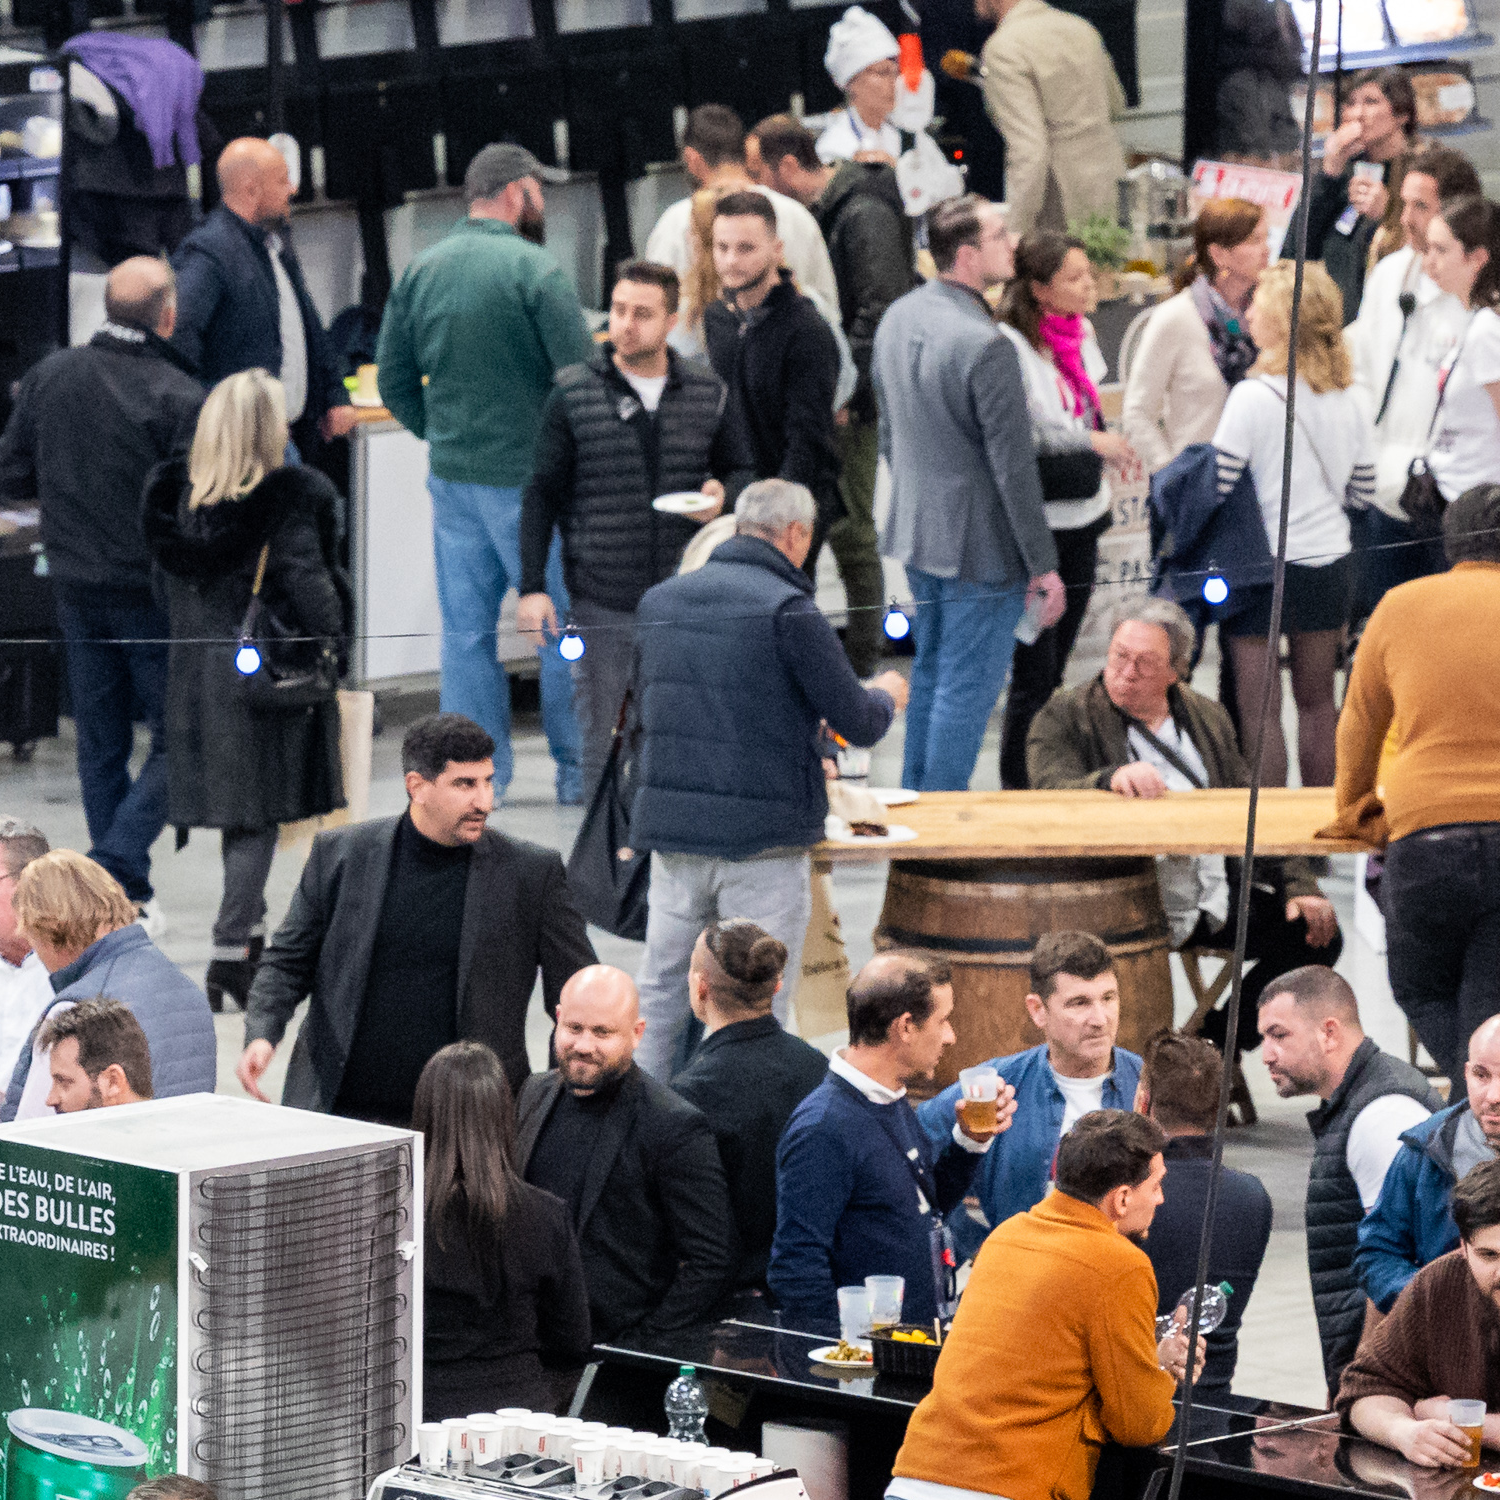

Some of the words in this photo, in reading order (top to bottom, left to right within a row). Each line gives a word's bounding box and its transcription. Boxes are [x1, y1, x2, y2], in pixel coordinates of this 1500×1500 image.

[9, 1164, 52, 1193] L'EAU,
[55, 1173, 75, 1194] DE
[78, 1177, 117, 1206] L'AIR,
[35, 1194, 116, 1236] BULLES
